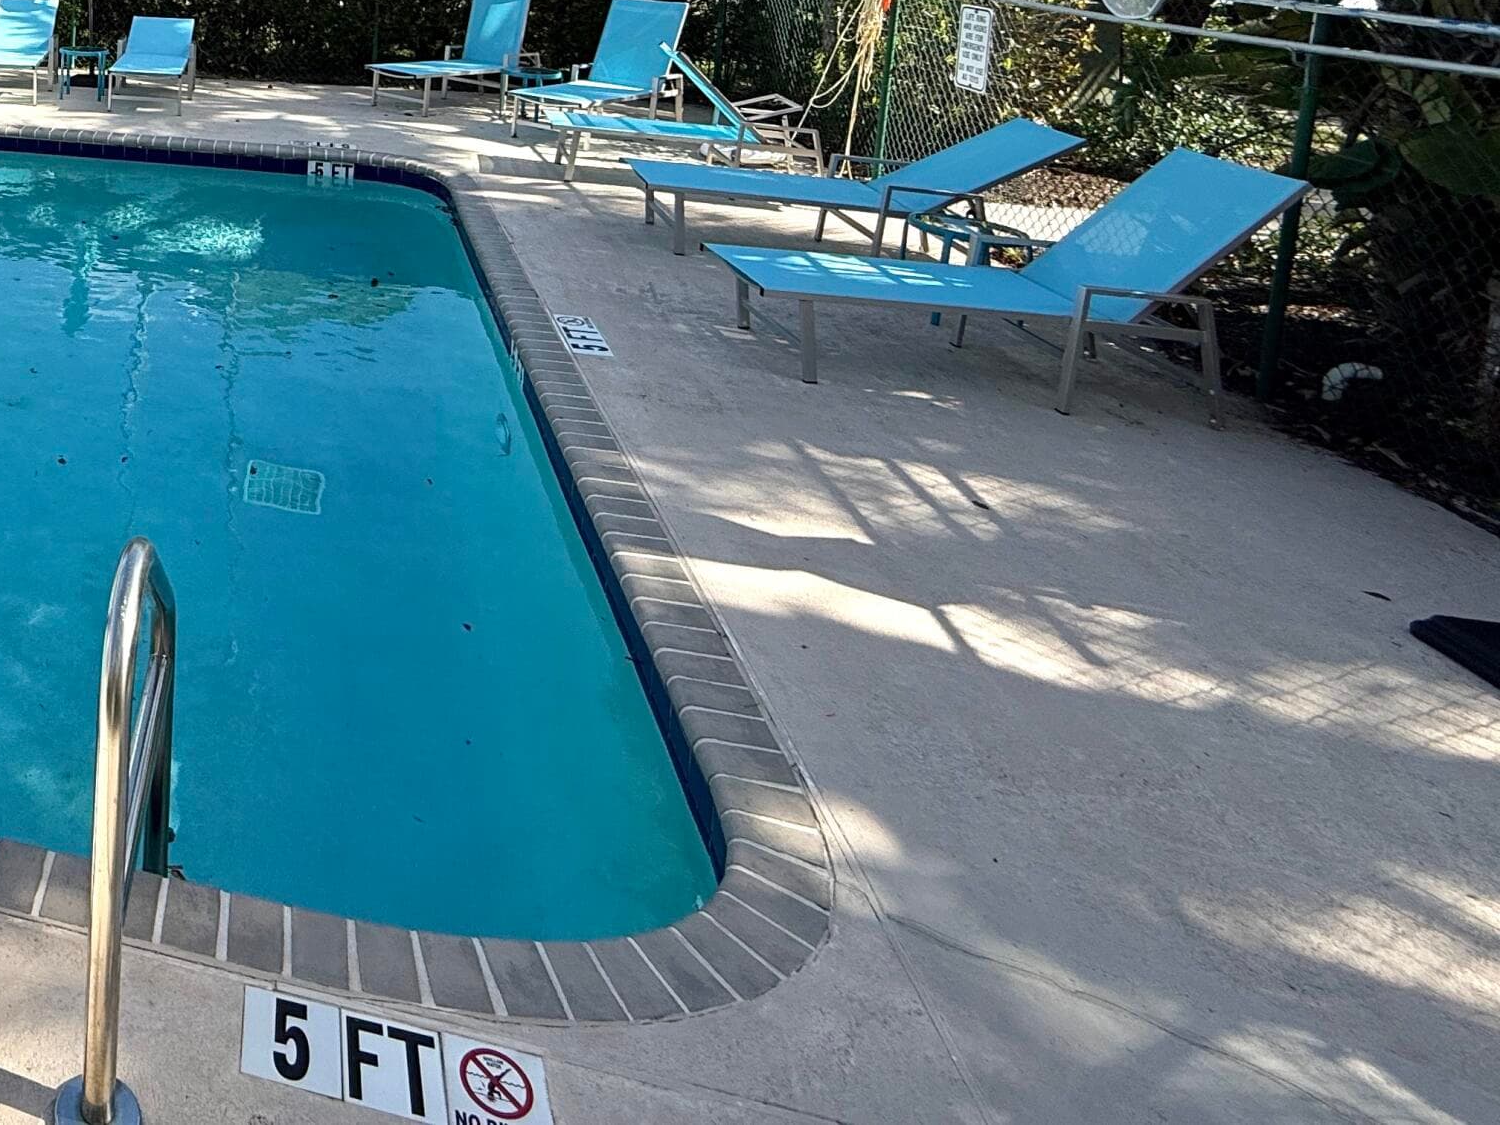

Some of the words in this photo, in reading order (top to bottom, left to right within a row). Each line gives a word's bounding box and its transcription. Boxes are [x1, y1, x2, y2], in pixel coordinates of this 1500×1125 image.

[961, 41, 985, 52] EMERGENCY
[971, 53, 983, 62] ONLY
[966, 65, 974, 73] NOT
[311, 162, 324, 176] 5
[332, 163, 354, 178] FT
[562, 326, 604, 342] FT
[570, 343, 609, 352] 5
[273, 997, 311, 1081] 5
[346, 1015, 436, 1118] FT
